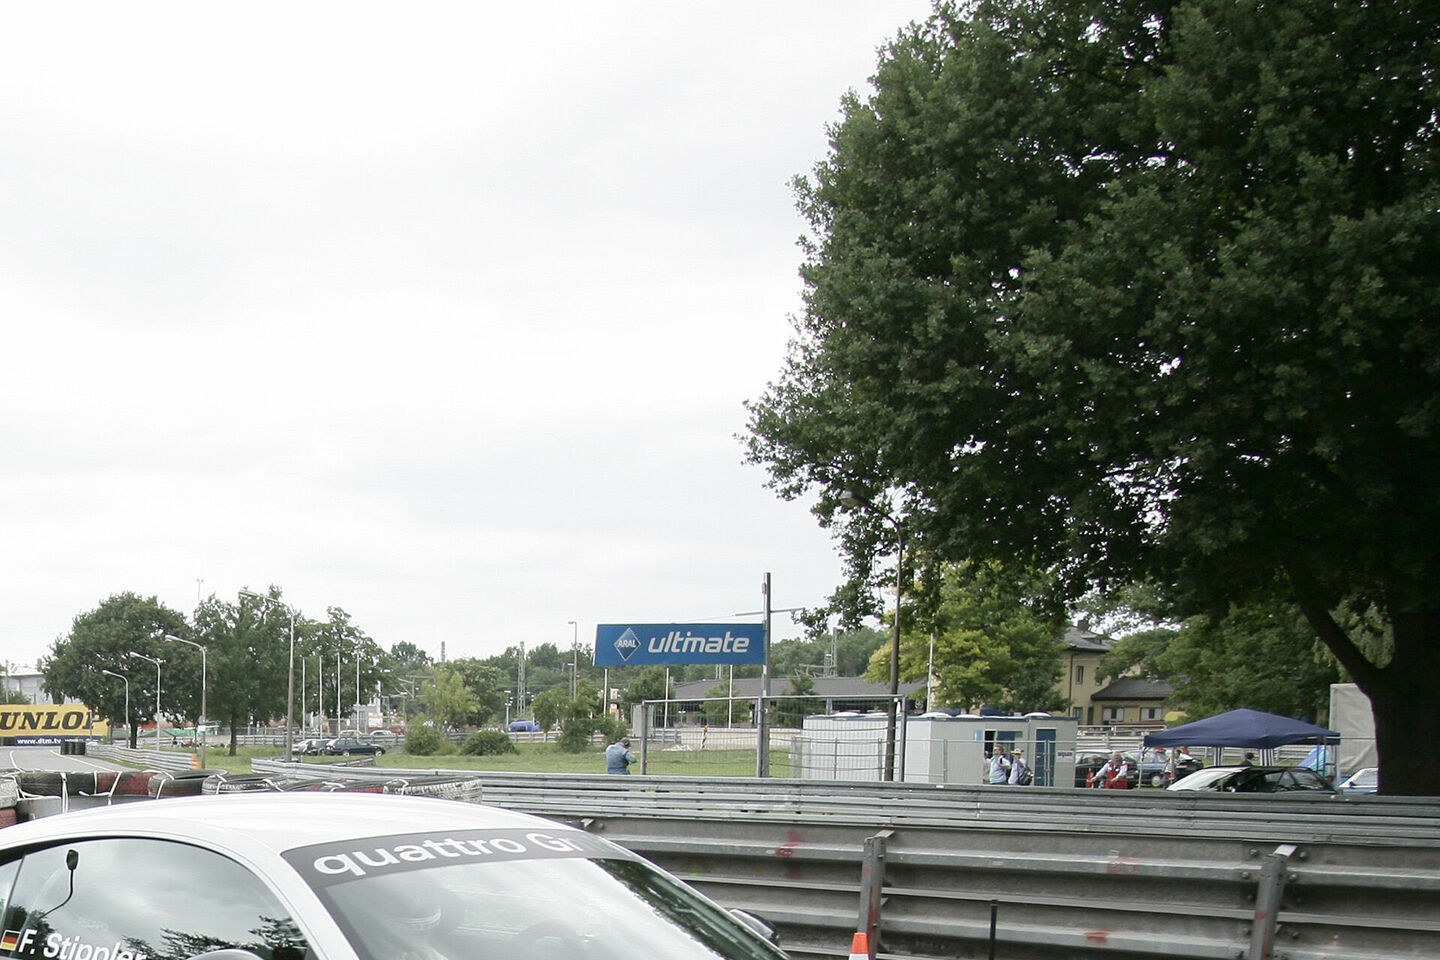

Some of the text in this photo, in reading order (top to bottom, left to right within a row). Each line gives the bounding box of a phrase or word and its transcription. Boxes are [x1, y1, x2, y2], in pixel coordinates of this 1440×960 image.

[617, 631, 750, 653] ARAL ultimate
[17, 737, 61, 745] www.dtm.tv
[313, 837, 528, 876] quattro
[18, 928, 38, 955] F.
